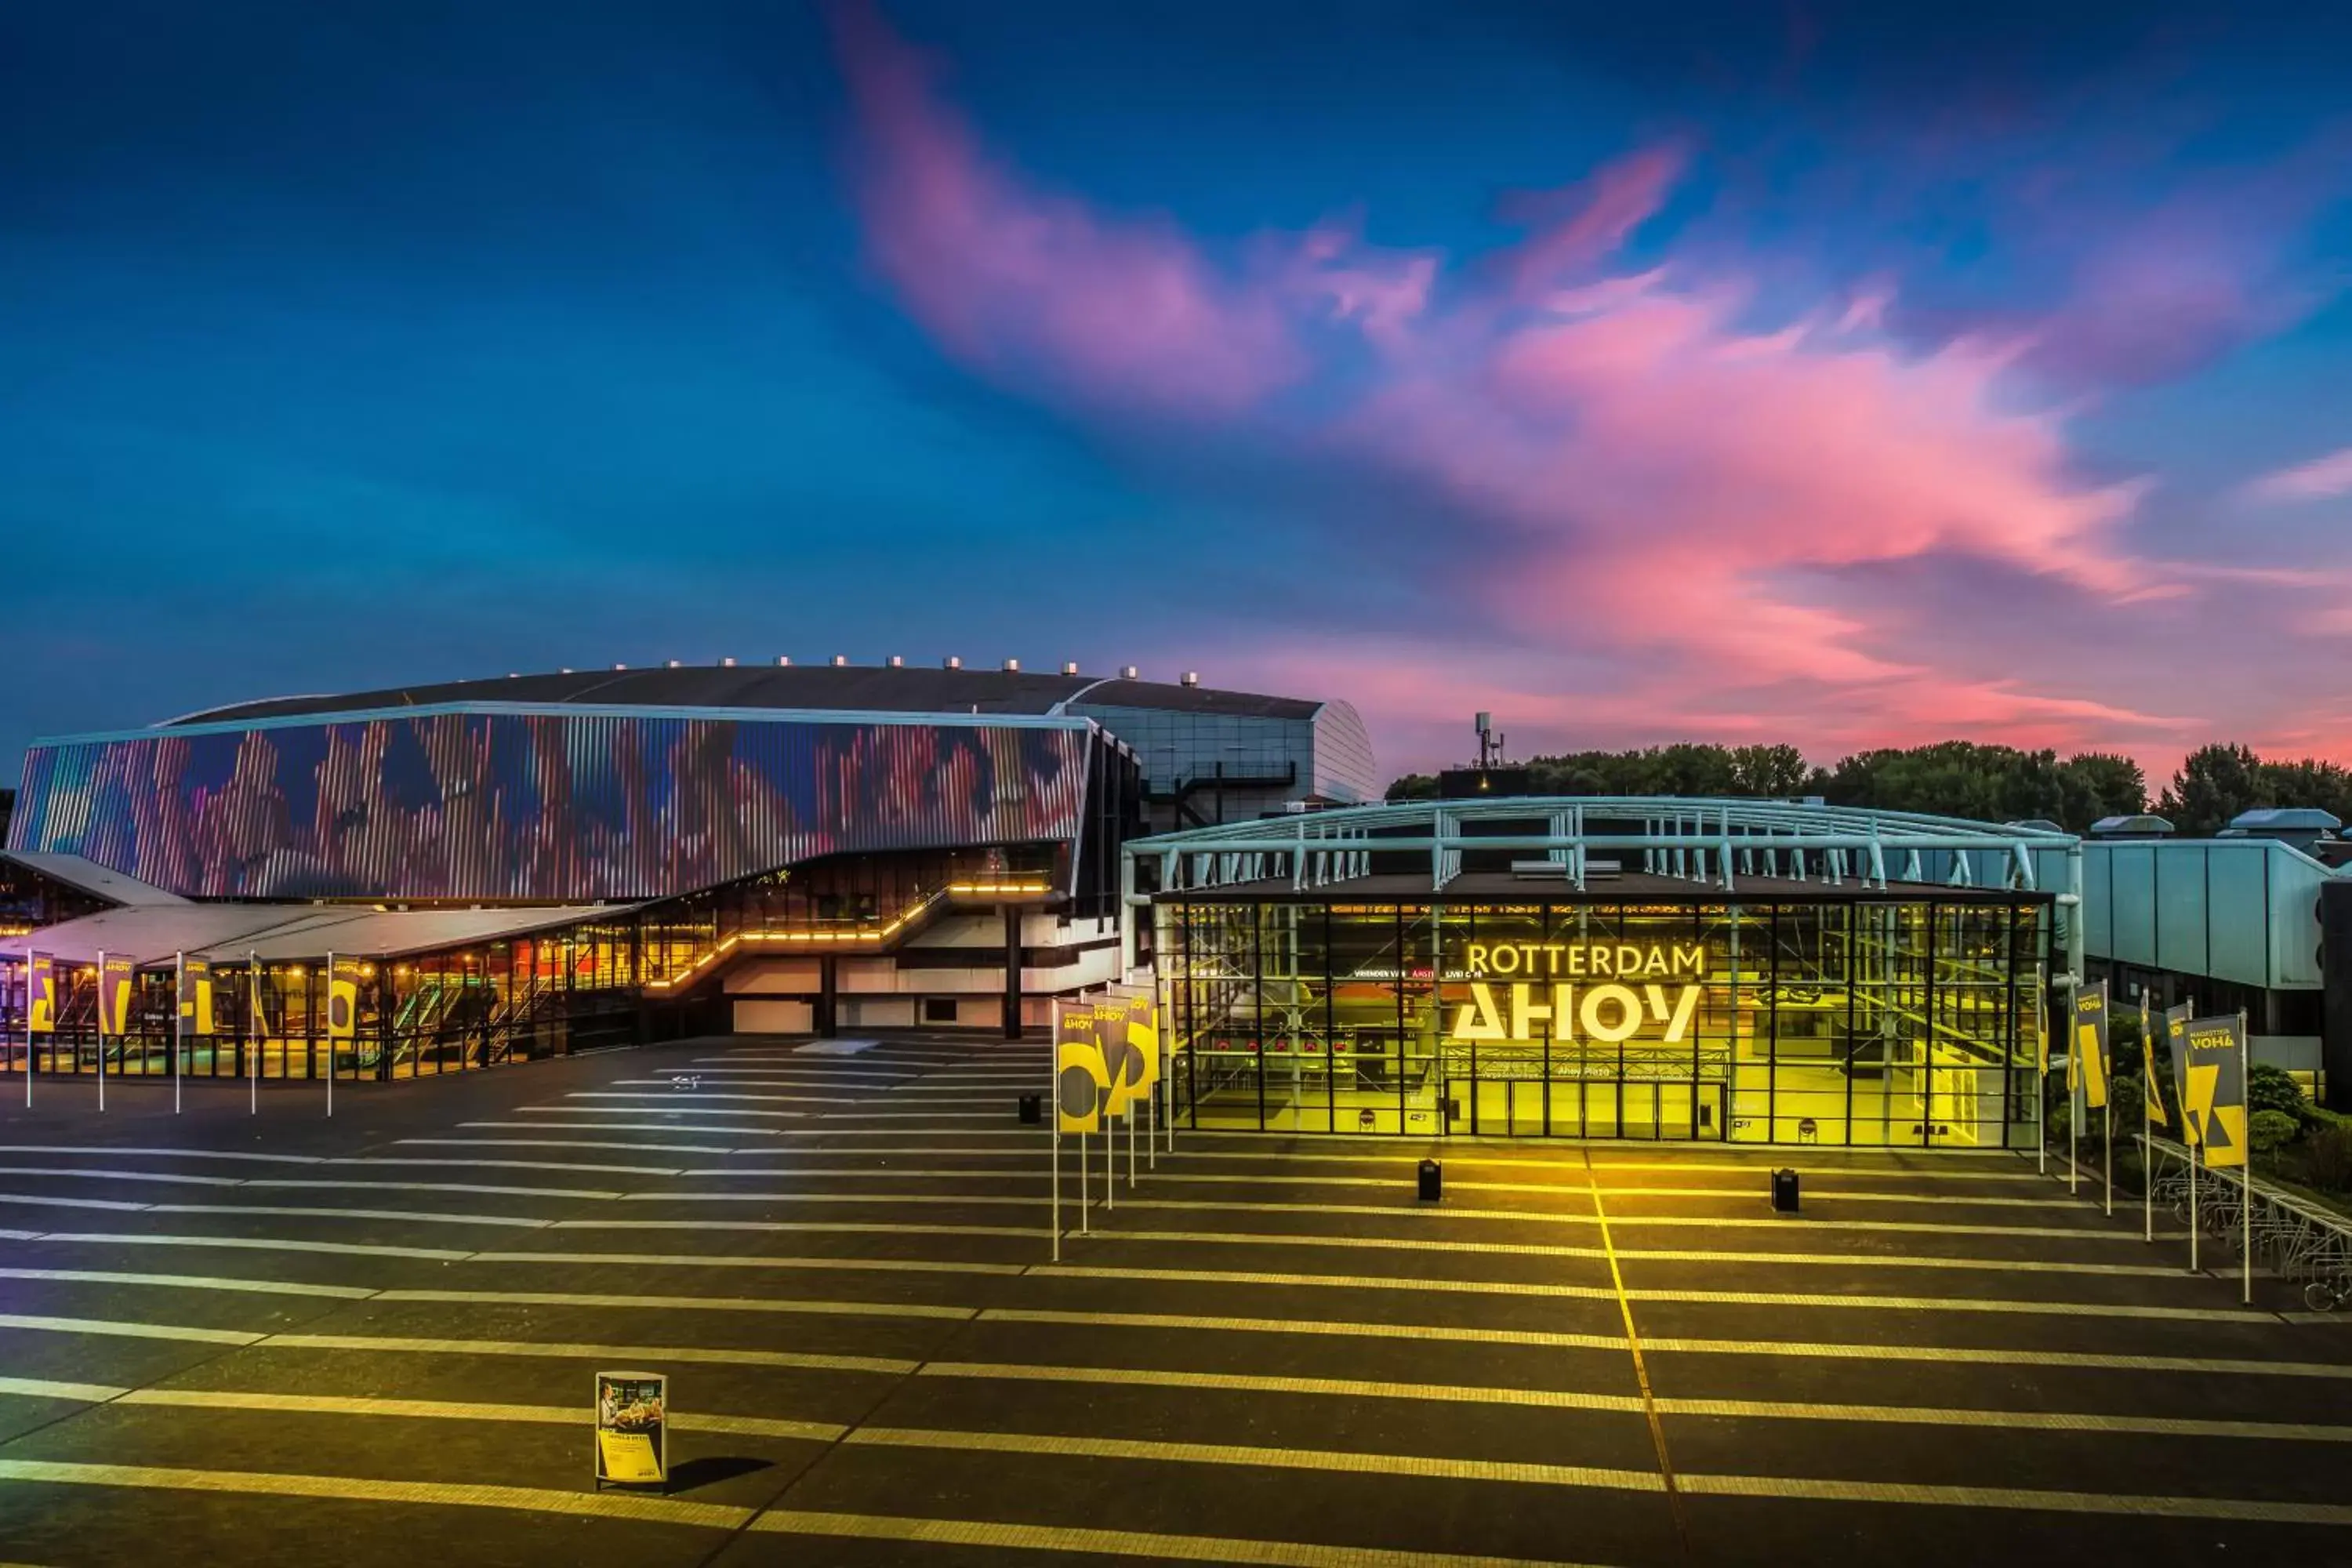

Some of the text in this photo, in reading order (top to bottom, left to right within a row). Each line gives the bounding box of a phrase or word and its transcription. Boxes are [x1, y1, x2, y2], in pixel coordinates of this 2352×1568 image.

[1468, 945, 1704, 975] ROTTERDAM
[1064, 1018, 1093, 1029] AHOY
[1453, 983, 1702, 1042] AHOY
